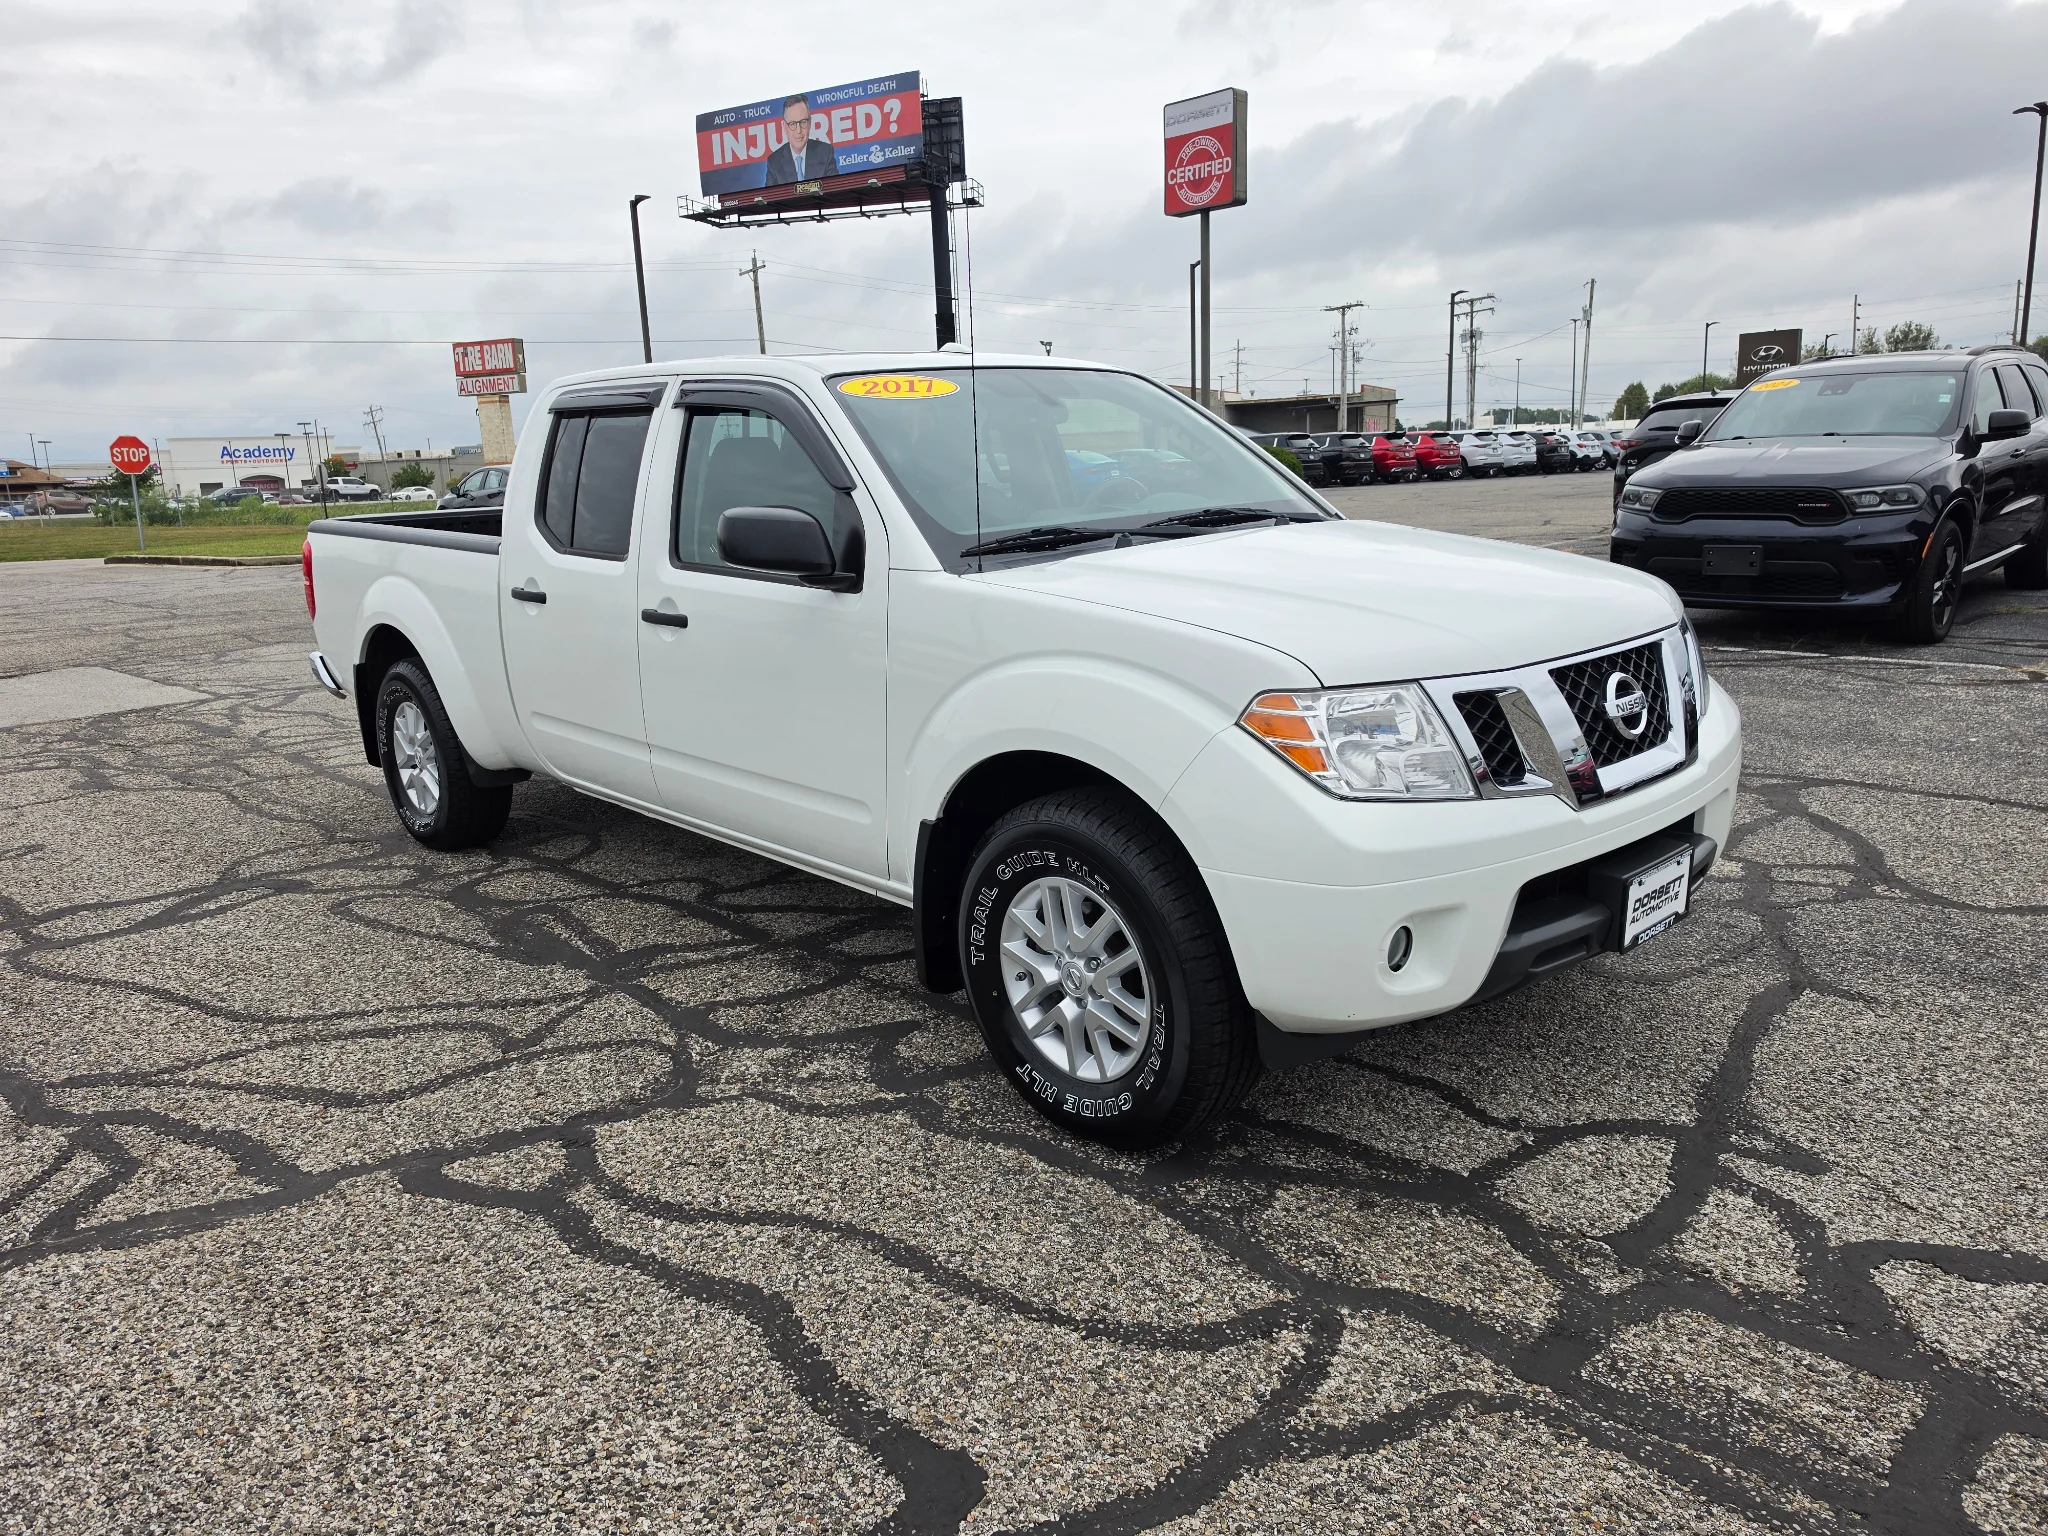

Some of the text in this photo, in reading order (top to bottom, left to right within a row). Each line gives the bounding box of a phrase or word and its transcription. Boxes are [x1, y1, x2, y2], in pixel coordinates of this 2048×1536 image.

[714, 80, 897, 125] AUTO TRUCK WRONGFUL DEATH
[1165, 101, 1232, 128] DORSETT
[711, 98, 902, 166] INJURED?
[838, 153, 869, 166] Keller
[884, 145, 916, 159] Keller
[1181, 137, 1219, 160] PRE-OWNED
[1167, 156, 1232, 185] CERTIFIED
[1179, 180, 1221, 204] AUTOMOBILES
[483, 342, 515, 370] BARN
[460, 376, 516, 394] ALIGNMENT
[861, 379, 934, 395] 2017
[112, 447, 148, 463] STOP
[220, 445, 296, 461] Academy
[1629, 889, 1681, 927] AUTOMOTIVE
[1632, 873, 1686, 915] DORSETT
[971, 851, 1110, 966] TRAIL GUIDE HLT
[1637, 915, 1676, 945] DORSETT
[1015, 1003, 1165, 1118] TRAIL GUIDE HLT
